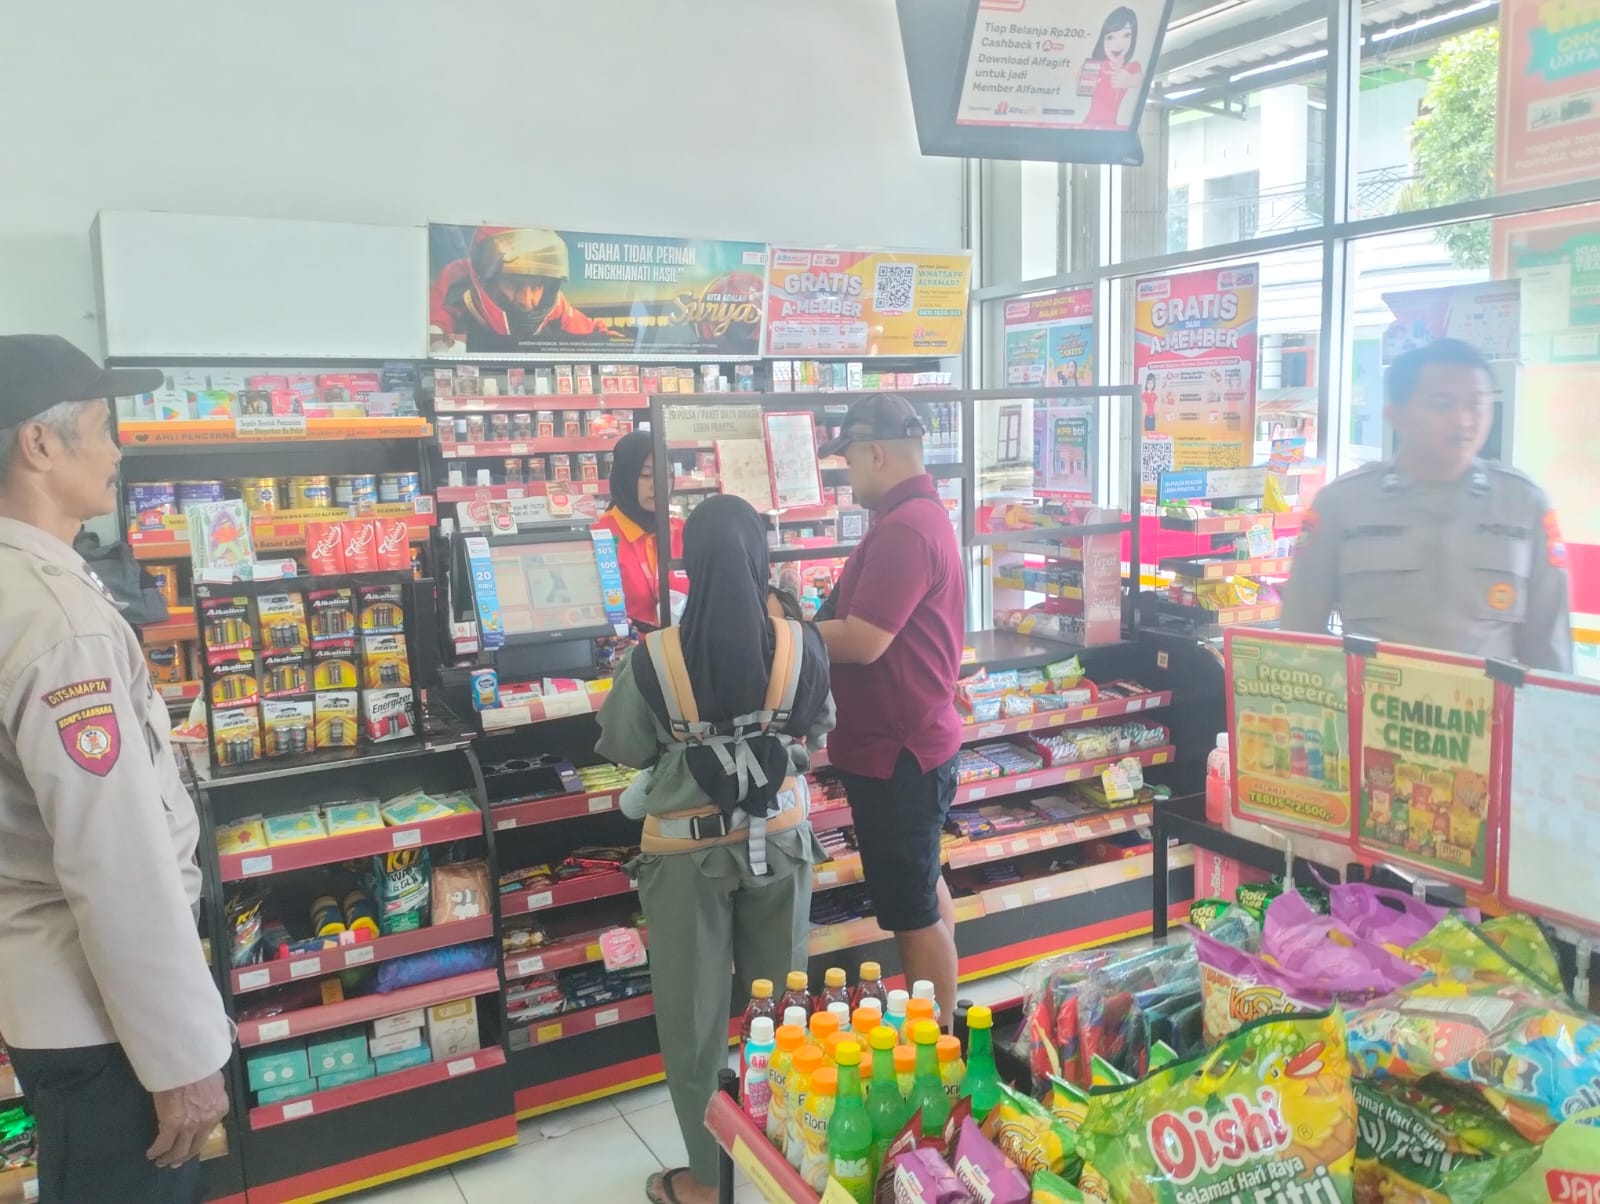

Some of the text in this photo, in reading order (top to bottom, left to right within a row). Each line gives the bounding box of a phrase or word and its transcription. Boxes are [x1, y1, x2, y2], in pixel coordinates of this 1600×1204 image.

[984, 22, 1007, 34] Tiap
[1009, 24, 1048, 37] Belanja
[981, 37, 1032, 50] Cashback
[978, 53, 1070, 70] Download Alfagift
[975, 69, 1027, 81] untuk jadi
[972, 82, 1060, 96] Member Alfamart
[624, 244, 653, 263] TIDAK
[656, 246, 696, 265] PERNAH
[584, 263, 650, 280] MENGKHIANATI
[784, 272, 862, 296] GRATIS
[668, 290, 763, 337] Surya
[1152, 293, 1238, 328] GRATIS
[476, 572, 492, 580] 20
[312, 598, 350, 608] Alkaline
[364, 592, 400, 602] Alkaline
[207, 606, 246, 617] Alkaline
[266, 655, 302, 665] Alkaline
[316, 648, 352, 658] Alkaline
[213, 662, 252, 674] Alkaline
[1258, 663, 1324, 688] Promo
[48, 680, 107, 705] DITSAMAPTA
[372, 692, 412, 714] Energizer
[1370, 692, 1487, 739] CEMILAN
[1382, 722, 1470, 763] CEBAN
[1248, 792, 1285, 808] TEBUS
[1352, 1087, 1446, 1154] lamat Hari Raya
[1149, 1086, 1288, 1180] Oishi
[834, 1158, 869, 1177] BIG
[1176, 1156, 1304, 1204] Selamat Hari Raya
